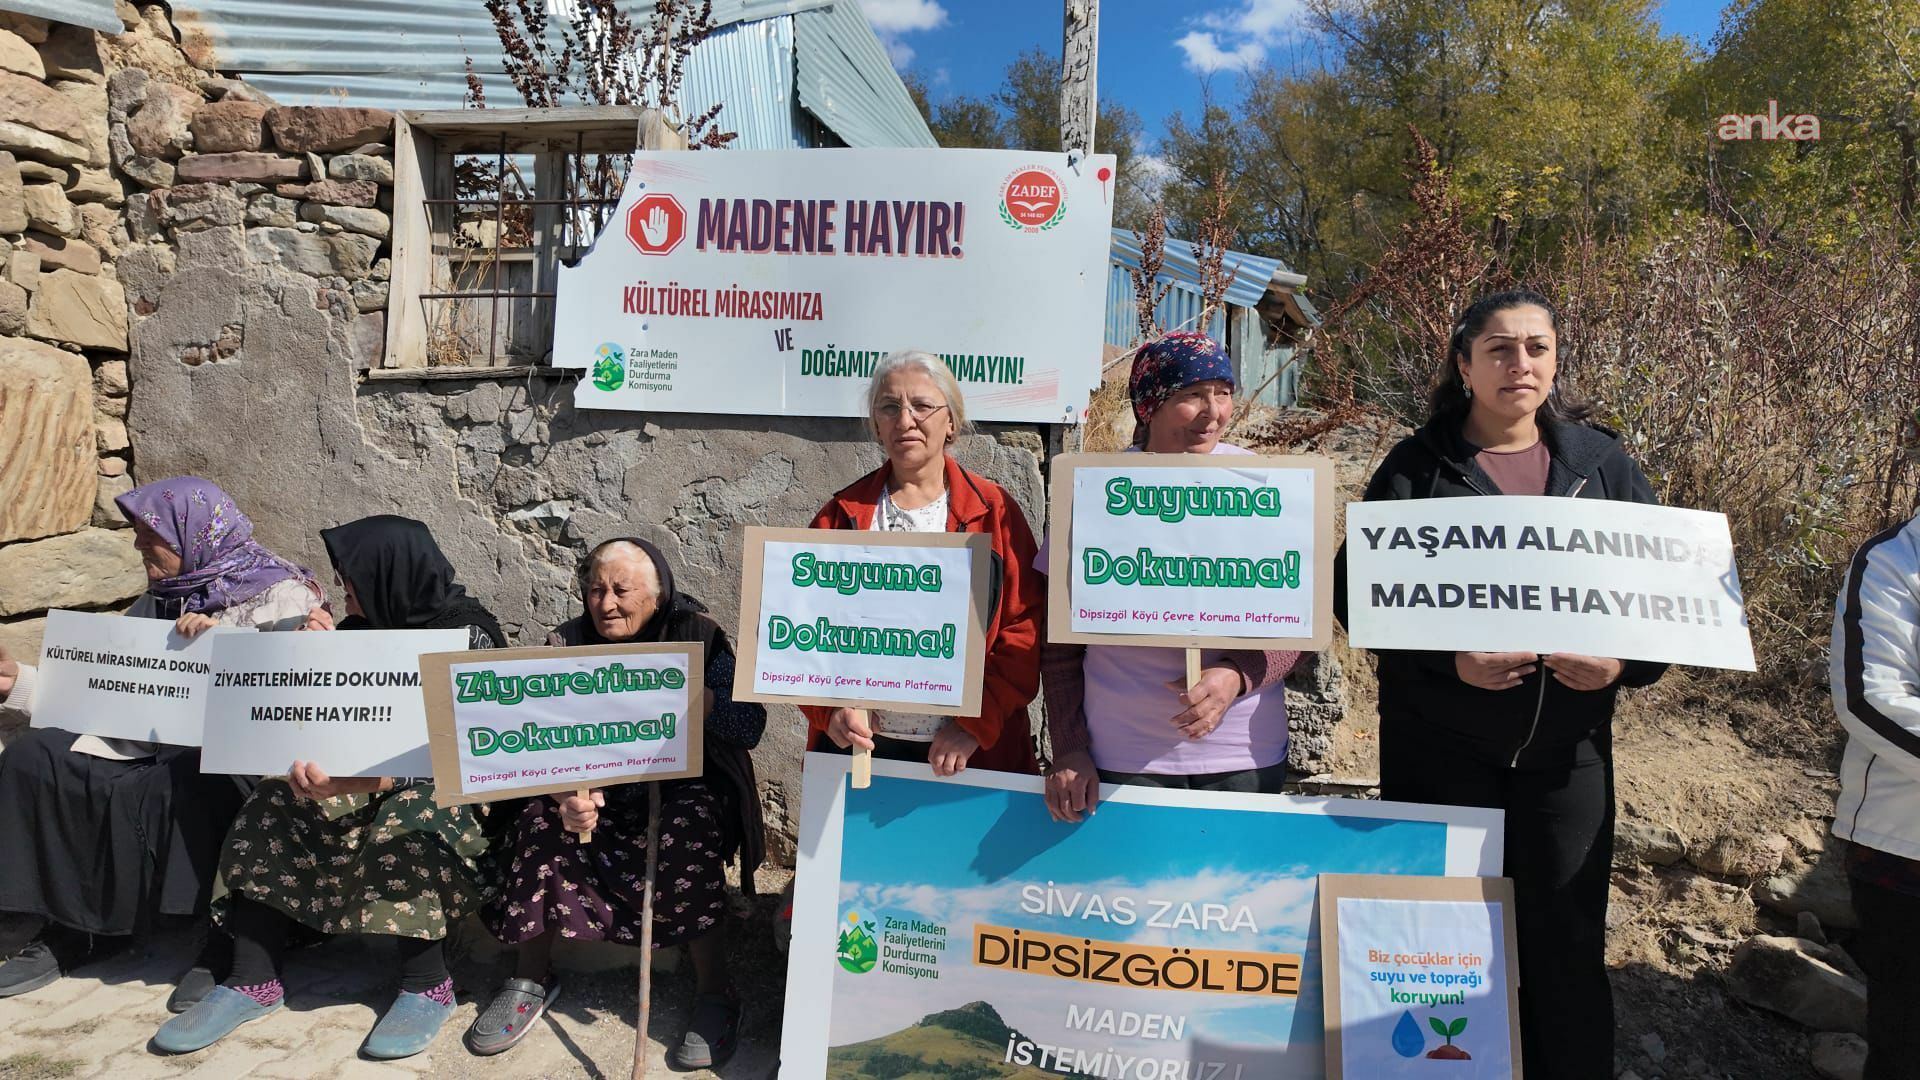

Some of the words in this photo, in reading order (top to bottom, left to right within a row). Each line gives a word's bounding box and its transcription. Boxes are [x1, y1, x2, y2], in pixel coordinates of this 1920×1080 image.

[1011, 184, 1057, 198] ZADEF
[696, 198, 837, 254] MADENE
[844, 199, 965, 258] HAYIR!
[623, 281, 710, 317] KÜLTÜREL
[714, 283, 823, 320] MİRASIMIZA
[774, 328, 795, 352] VE
[630, 348, 649, 358] Zara
[650, 349, 678, 359] Maden
[801, 344, 888, 378] DOĞAMIZ
[629, 359, 678, 370] Faaliyetlerini
[629, 370, 671, 380] Durdurma
[628, 381, 672, 392] Komisyonu
[1105, 476, 1282, 523] Suyuma
[1360, 525, 1506, 558] YAŞAM
[792, 552, 942, 595] Suyuma
[1082, 547, 1301, 589] Dokunma!
[1371, 583, 1542, 611] MADENE
[1550, 586, 1722, 627] HAYIR!!!
[1079, 608, 1127, 622] Dipsizgöl
[1132, 610, 1158, 623] Köyü
[1162, 611, 1194, 622] Çevre
[1200, 612, 1240, 622] Koruma
[1245, 612, 1300, 624] Platformu
[768, 615, 956, 659] Dokunma!
[46, 645, 95, 664] KÜLTÜREL
[96, 651, 167, 671] MİRASIMIZA
[214, 668, 332, 687] ZİYARETLERİMİZE
[336, 672, 422, 687] DOKUNM
[456, 662, 686, 705] Ziyaretime
[762, 672, 804, 683] Dipsizgöl
[808, 674, 831, 686] Köyü
[834, 676, 862, 686] Çevre
[866, 678, 901, 688] Koruma
[904, 680, 952, 692] Platformu
[88, 678, 136, 694] MADENE
[138, 682, 190, 699] HAYIR!!!
[250, 706, 313, 721] MADENE
[316, 706, 392, 722] HAYIR!!!
[468, 712, 676, 756] Dokunma!
[469, 771, 517, 784] Dipsizgöl
[522, 768, 548, 779] Köyü
[550, 766, 580, 776] Çevre
[586, 762, 623, 770] Koruma
[627, 756, 676, 766] Platformu
[1020, 880, 1137, 926] SİVAS
[1146, 900, 1258, 934] ZARA
[885, 916, 908, 930] Zara
[911, 920, 946, 936] Maden
[884, 931, 946, 950] Faaliyetlerini
[883, 946, 937, 964] Durdurma
[1369, 950, 1390, 963] Biz
[1394, 952, 1454, 967] çocuklar
[1458, 953, 1482, 968] için
[882, 960, 939, 979] Komisyonu
[1370, 971, 1406, 985] suyu
[1409, 973, 1427, 984] ve
[1430, 971, 1482, 988] toprağı
[1390, 987, 1464, 1008] koruyun!
[1066, 1004, 1186, 1041] MADEN
